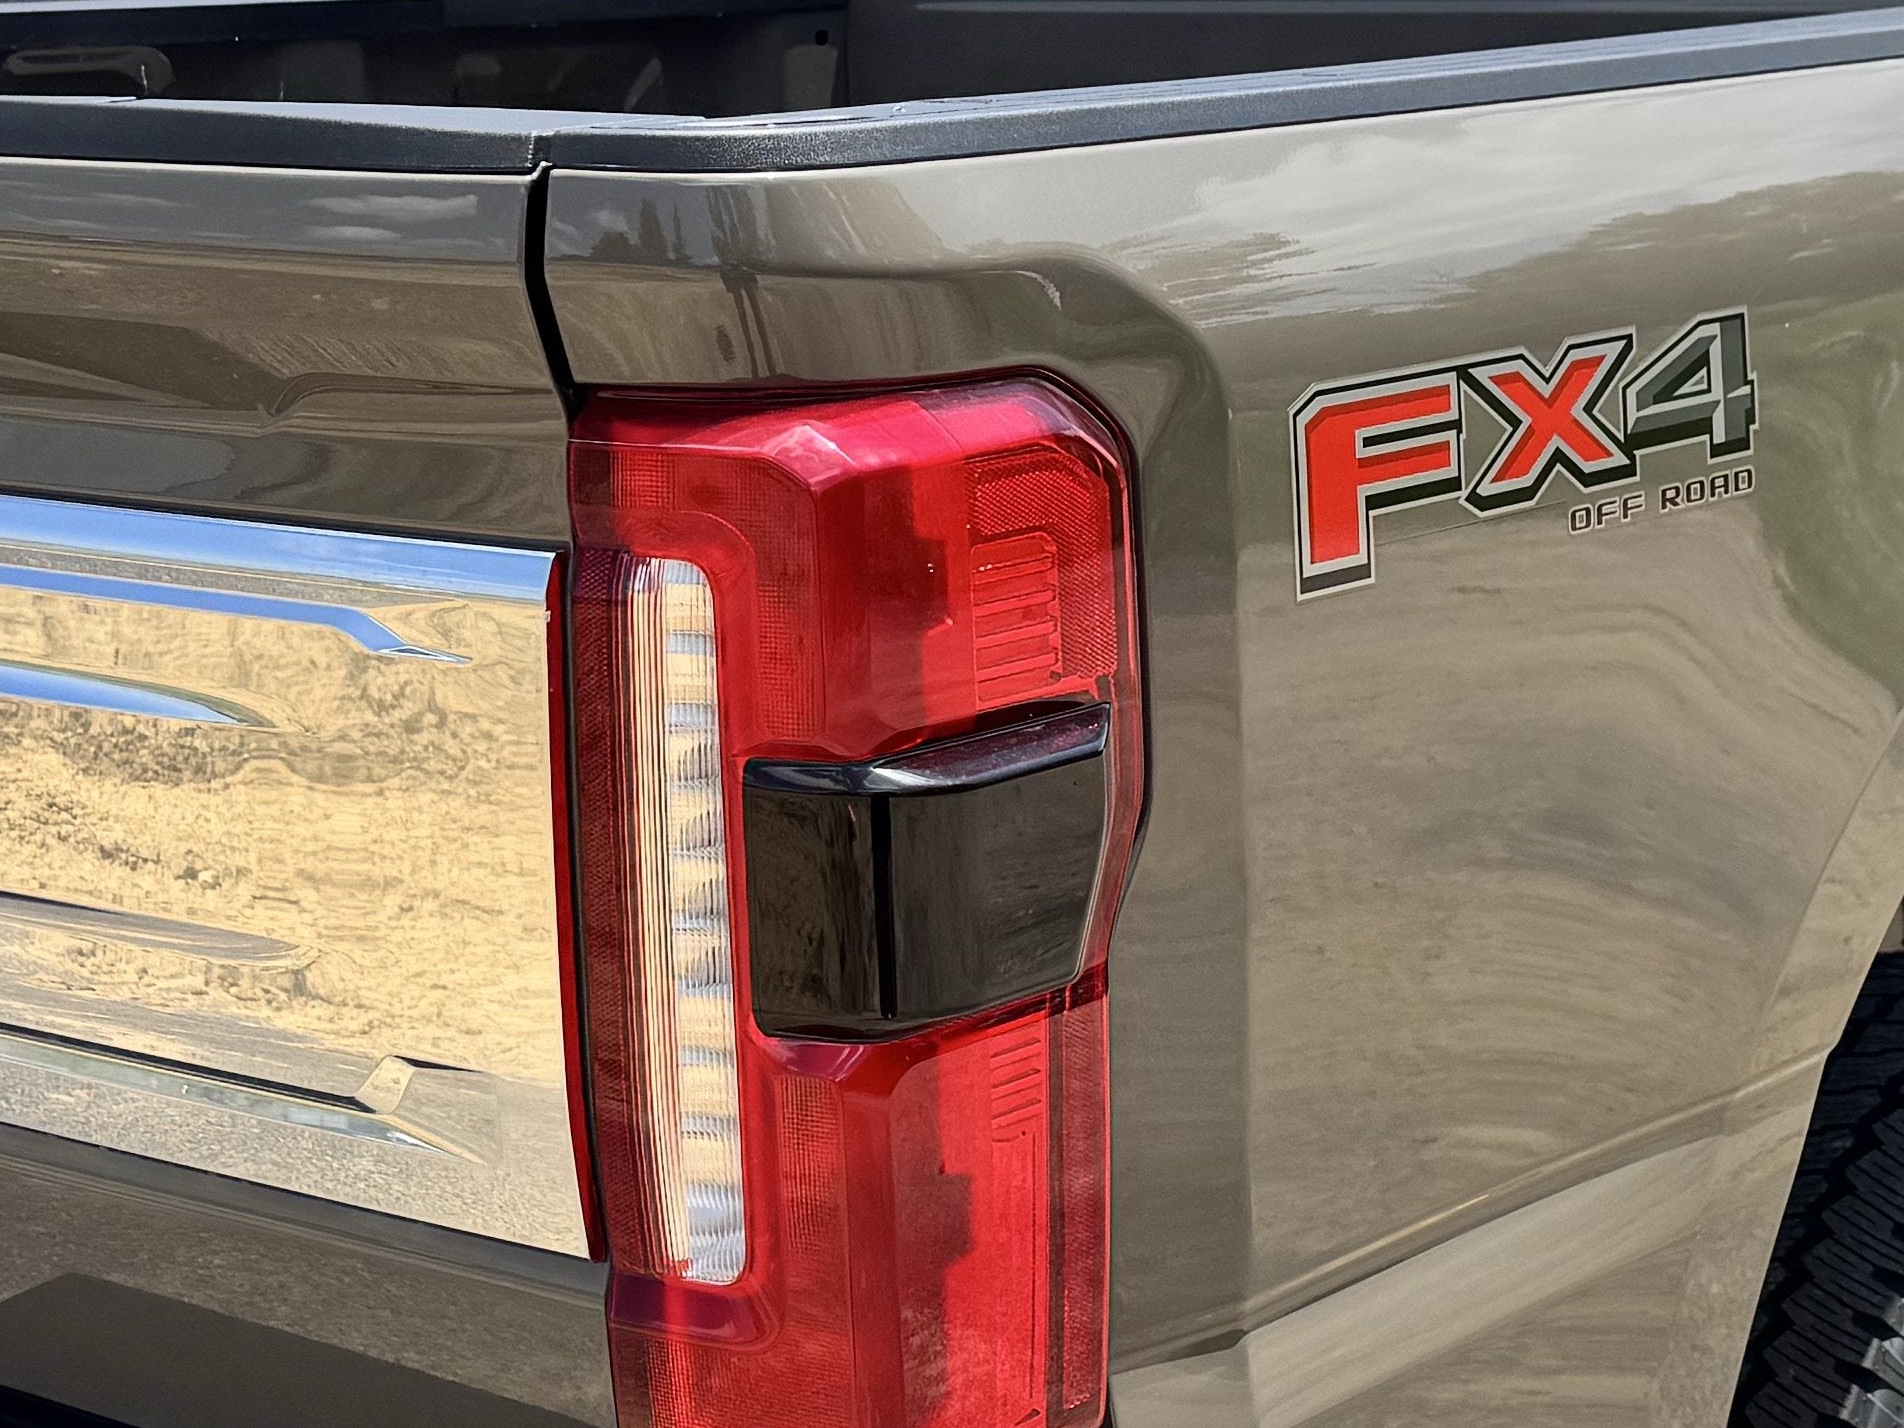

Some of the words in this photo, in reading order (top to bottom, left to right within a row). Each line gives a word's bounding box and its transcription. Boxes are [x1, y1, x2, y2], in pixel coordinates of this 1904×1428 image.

[1288, 305, 1759, 602] FX4
[1568, 493, 1645, 535] OFF
[1660, 466, 1755, 514] ROAD
